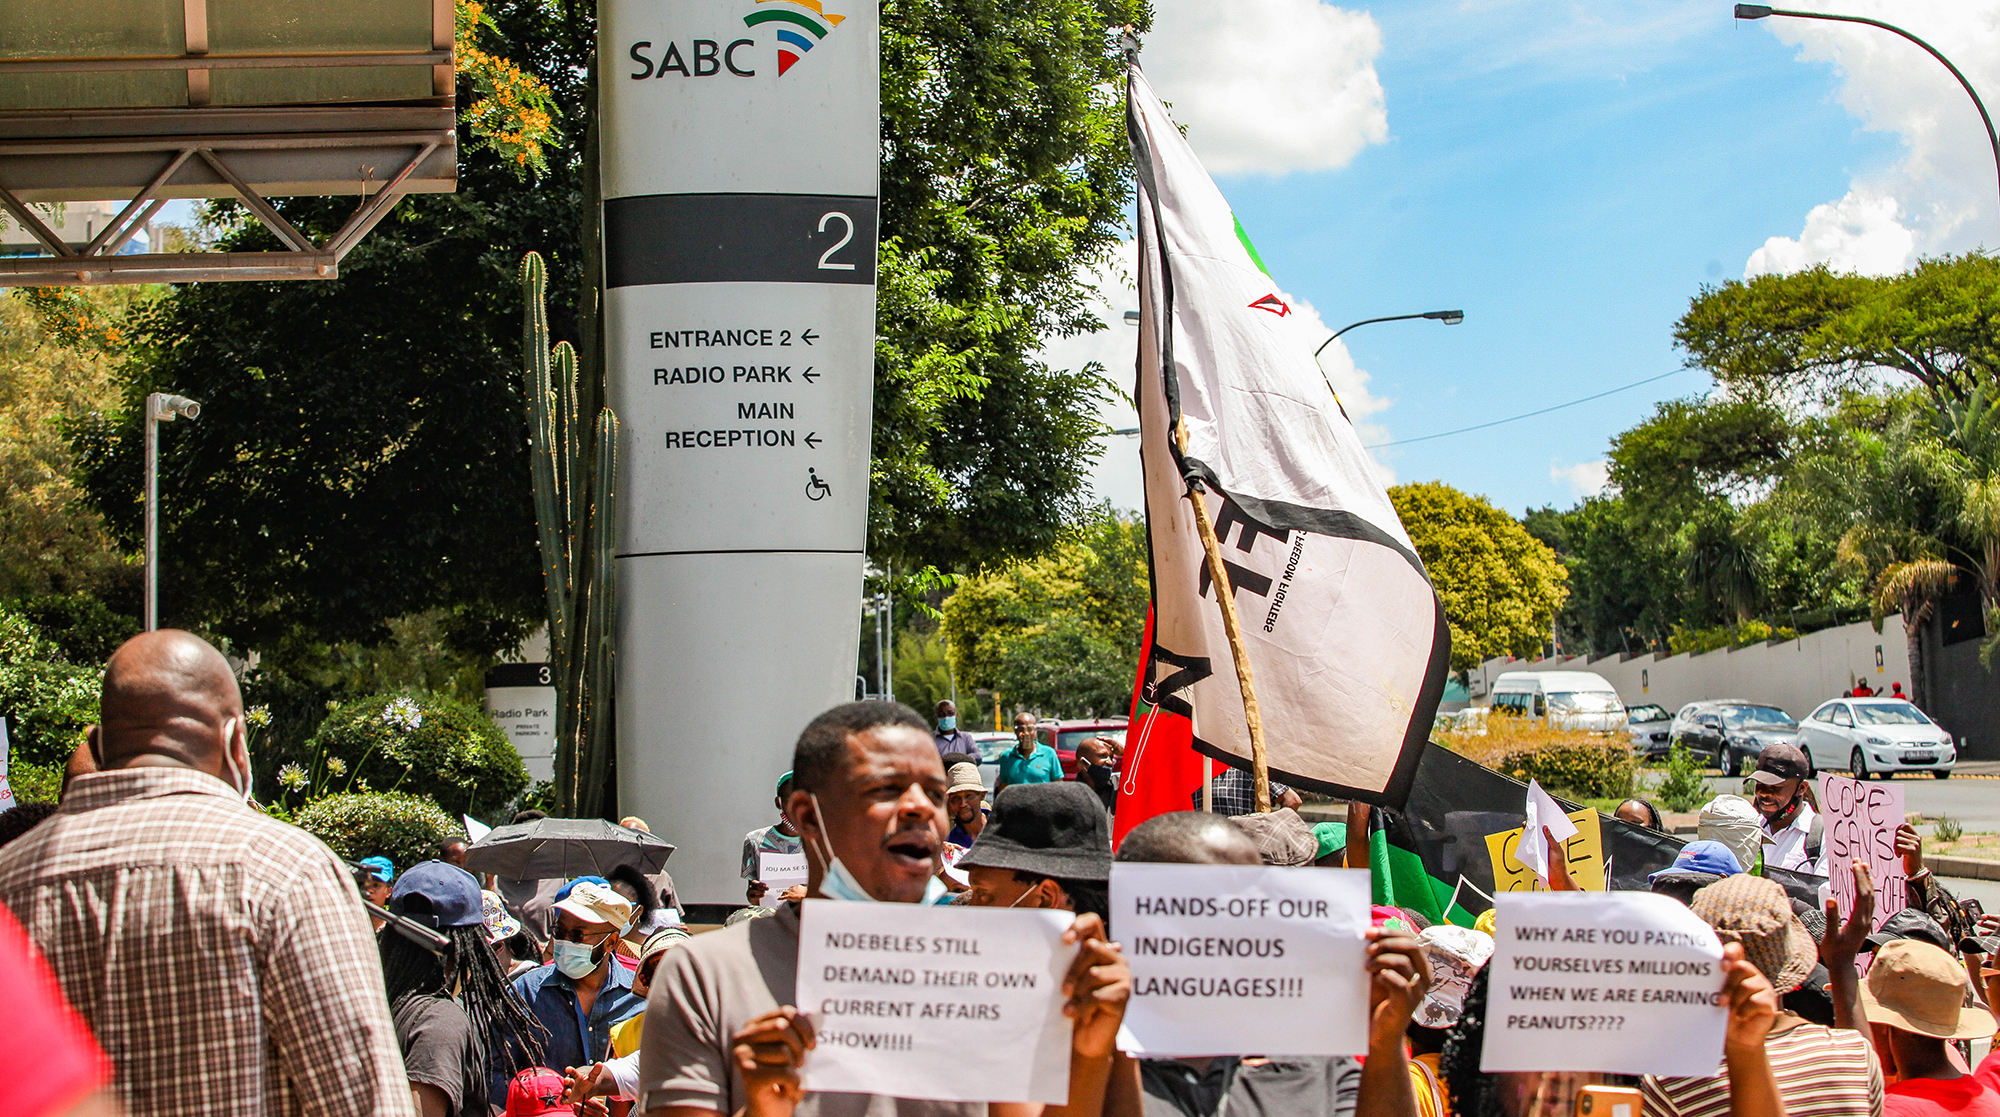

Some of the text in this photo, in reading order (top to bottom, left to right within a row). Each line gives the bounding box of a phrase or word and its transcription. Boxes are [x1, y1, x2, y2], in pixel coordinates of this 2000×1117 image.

[630, 39, 755, 80] SABC
[817, 211, 856, 271] 2
[650, 330, 792, 349] ENTRANCE 2
[653, 366, 793, 385] RADIO PARK
[738, 402, 795, 420] MAIN
[665, 430, 795, 449] RECEPTION
[539, 667, 551, 684] 3
[492, 708, 549, 719] Radio Park
[1825, 776, 1885, 826] COPE
[1833, 820, 1894, 869] SAYS
[1135, 897, 1329, 918] HANDS-OFF OUR
[825, 932, 981, 955] NDEBELES STILL
[1134, 936, 1285, 957] INDIGENOUS
[1515, 926, 1706, 947] WHY ARE YOU PAYING
[823, 965, 1037, 988] DEMAND THEIR OWN
[1513, 956, 1711, 976] YOURSELVES MILLIONS
[1133, 977, 1304, 998] LANGUAGES!!!
[1510, 985, 1721, 1007] WHEN WE ARE EARNING
[821, 998, 1001, 1021] CURRENT AFFAIRS
[1507, 1015, 1625, 1030] PEANUTS????
[817, 1030, 913, 1051] SHOW!!!!
